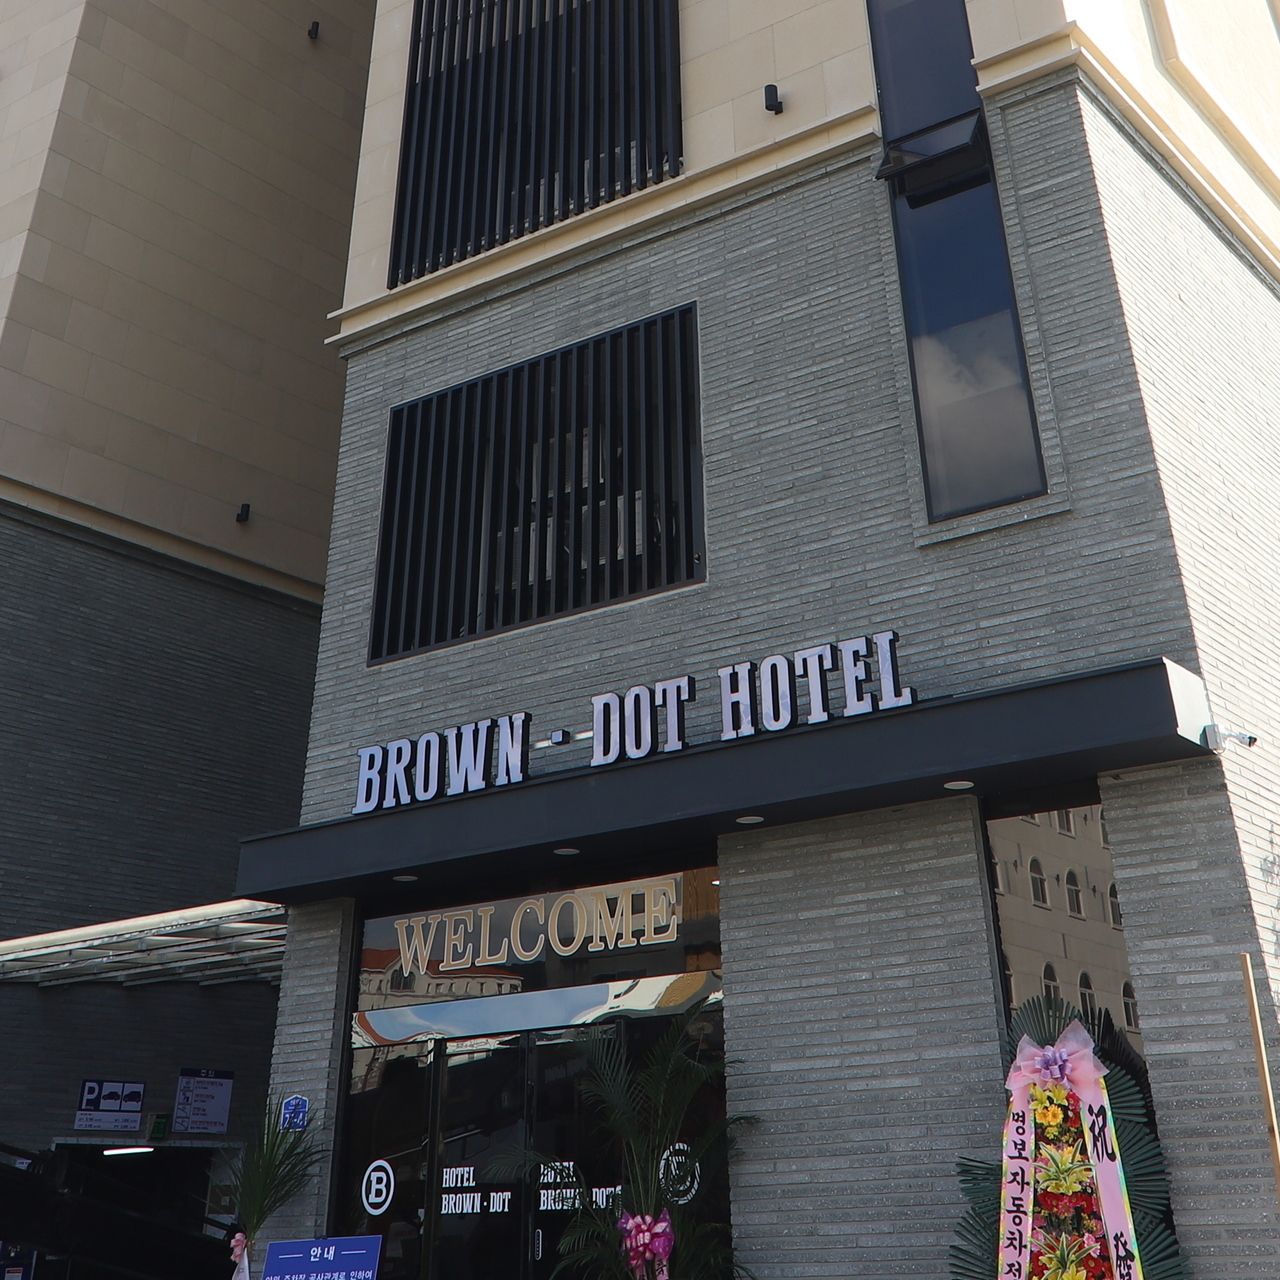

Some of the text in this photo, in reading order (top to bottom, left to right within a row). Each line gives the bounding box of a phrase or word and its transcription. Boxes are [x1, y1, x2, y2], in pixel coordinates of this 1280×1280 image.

[351, 630, 914, 815] BROWN DOT HOTEL
[394, 879, 678, 977] WELCOME
[442, 1166, 476, 1187] HOTEL
[440, 1191, 511, 1214] BROWN DOT
[310, 1245, 336, 1262] 안내
